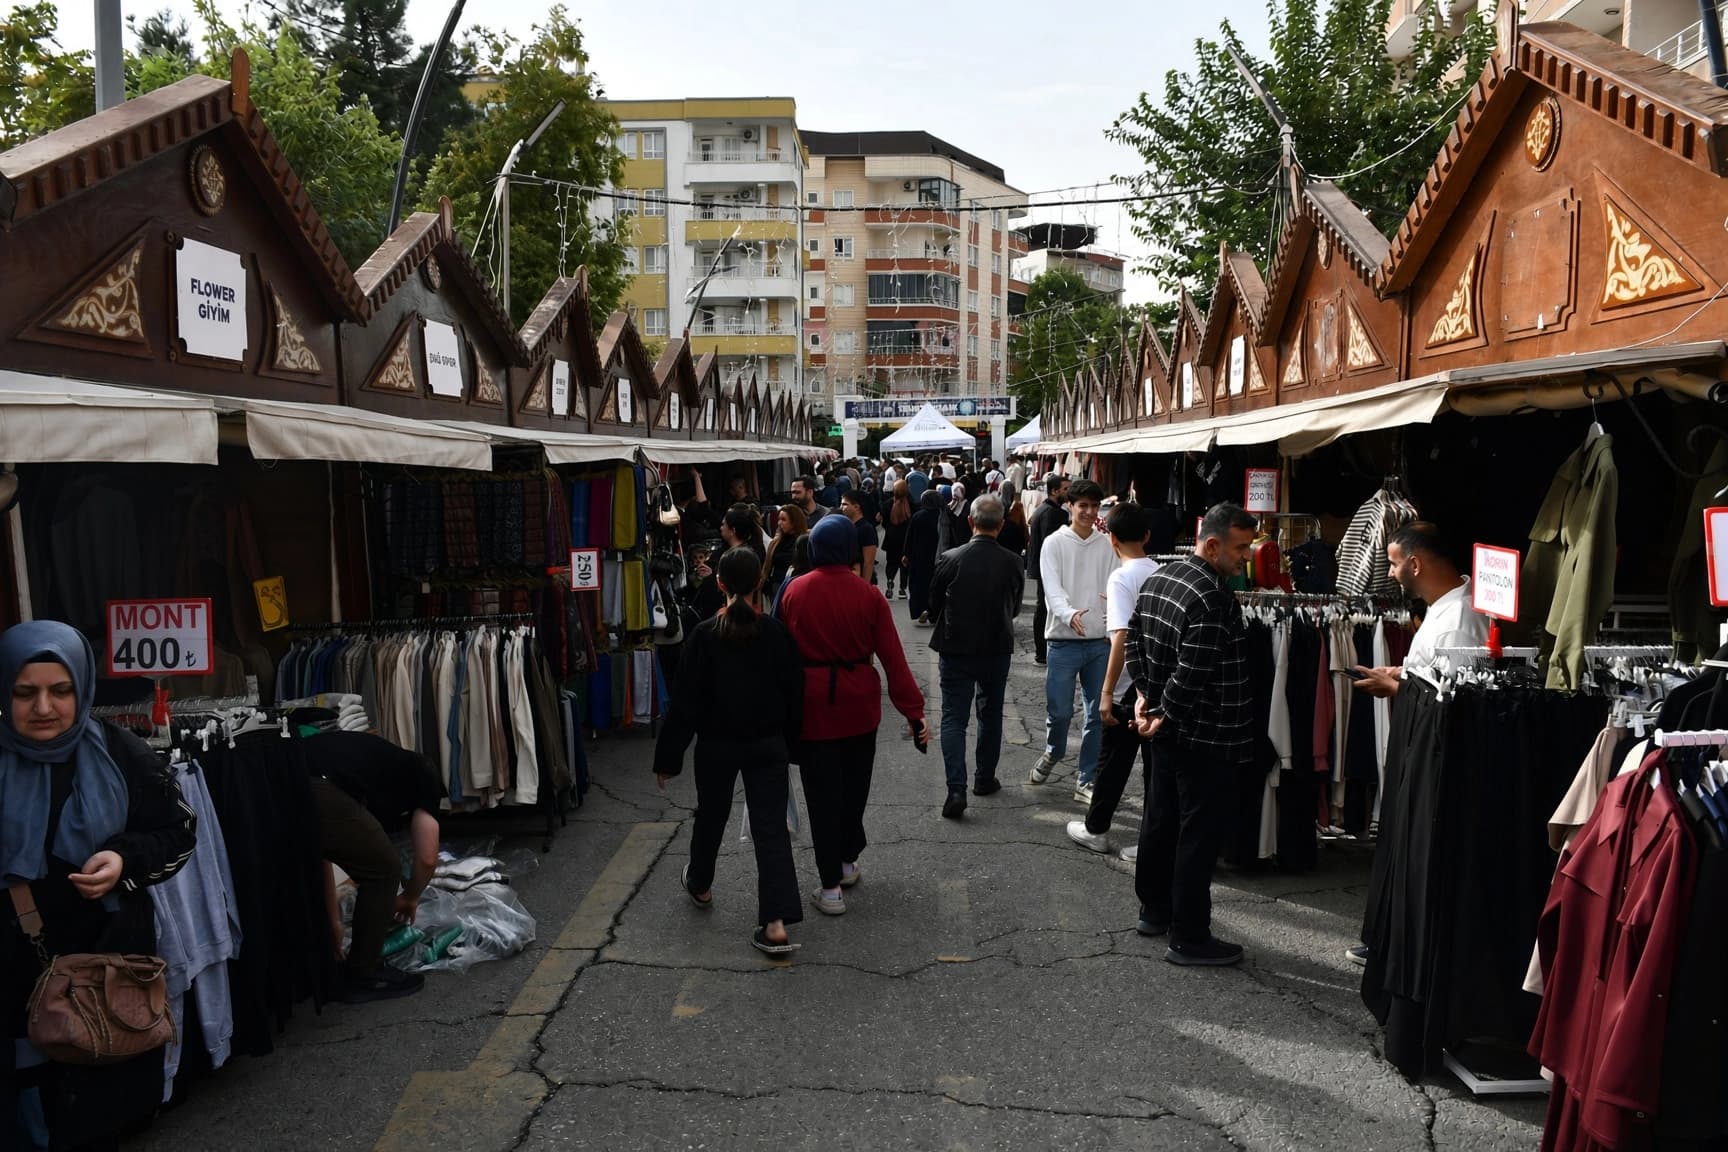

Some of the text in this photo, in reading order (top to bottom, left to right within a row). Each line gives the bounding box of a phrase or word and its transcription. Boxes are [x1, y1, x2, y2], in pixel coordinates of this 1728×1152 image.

[191, 278, 235, 303] FLOWER
[199, 299, 230, 324] GİYİM
[1249, 492, 1264, 501] 200
[1479, 571, 1513, 589] PANTOLON
[115, 604, 202, 630] MONT
